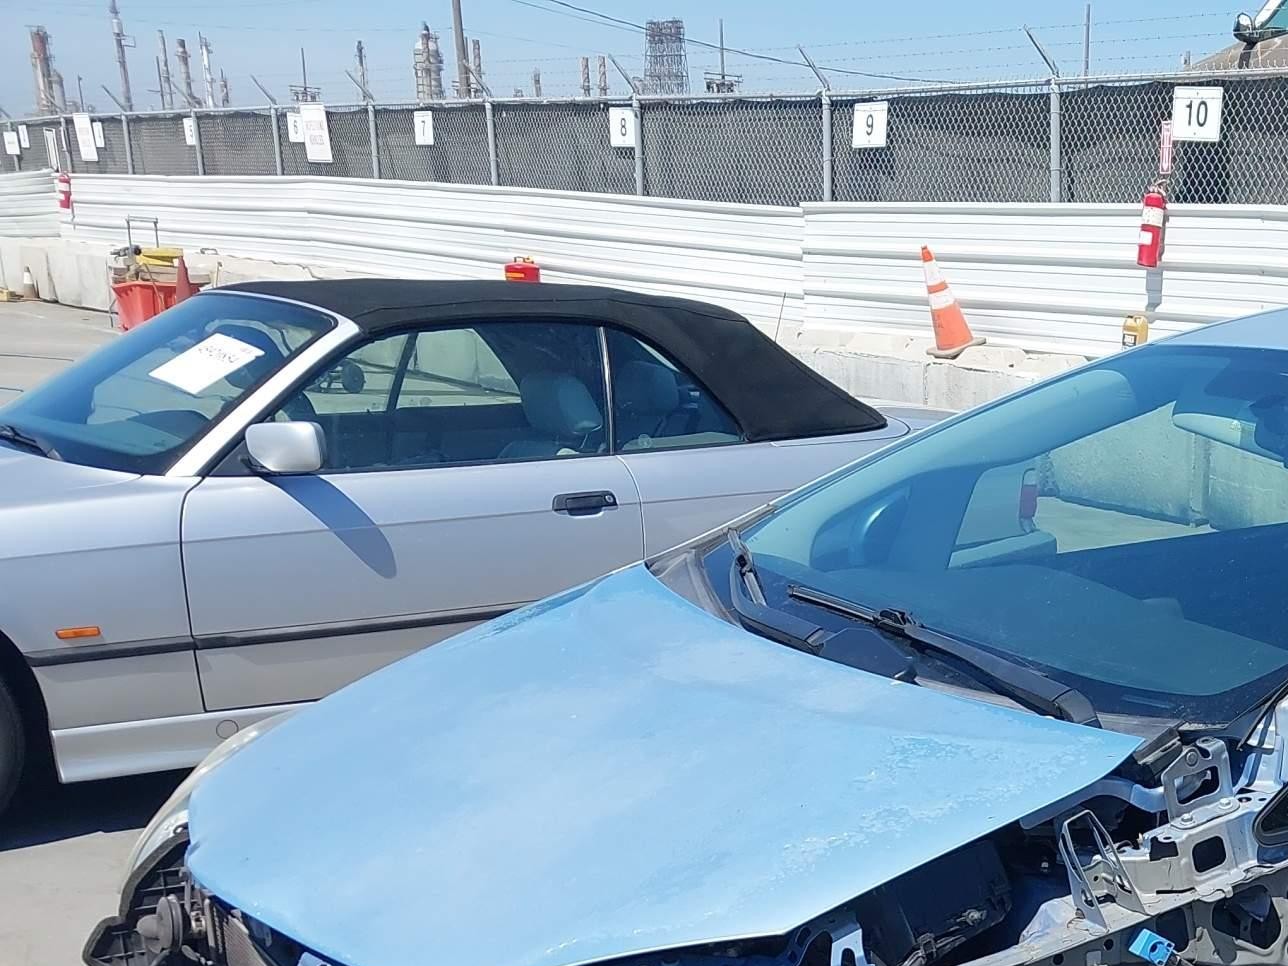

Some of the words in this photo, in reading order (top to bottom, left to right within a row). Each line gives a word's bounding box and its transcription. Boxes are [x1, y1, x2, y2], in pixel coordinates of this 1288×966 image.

[1185, 99, 1209, 128] 10
[293, 119, 299, 135] 6
[620, 117, 627, 137] 8
[865, 113, 874, 136] 9
